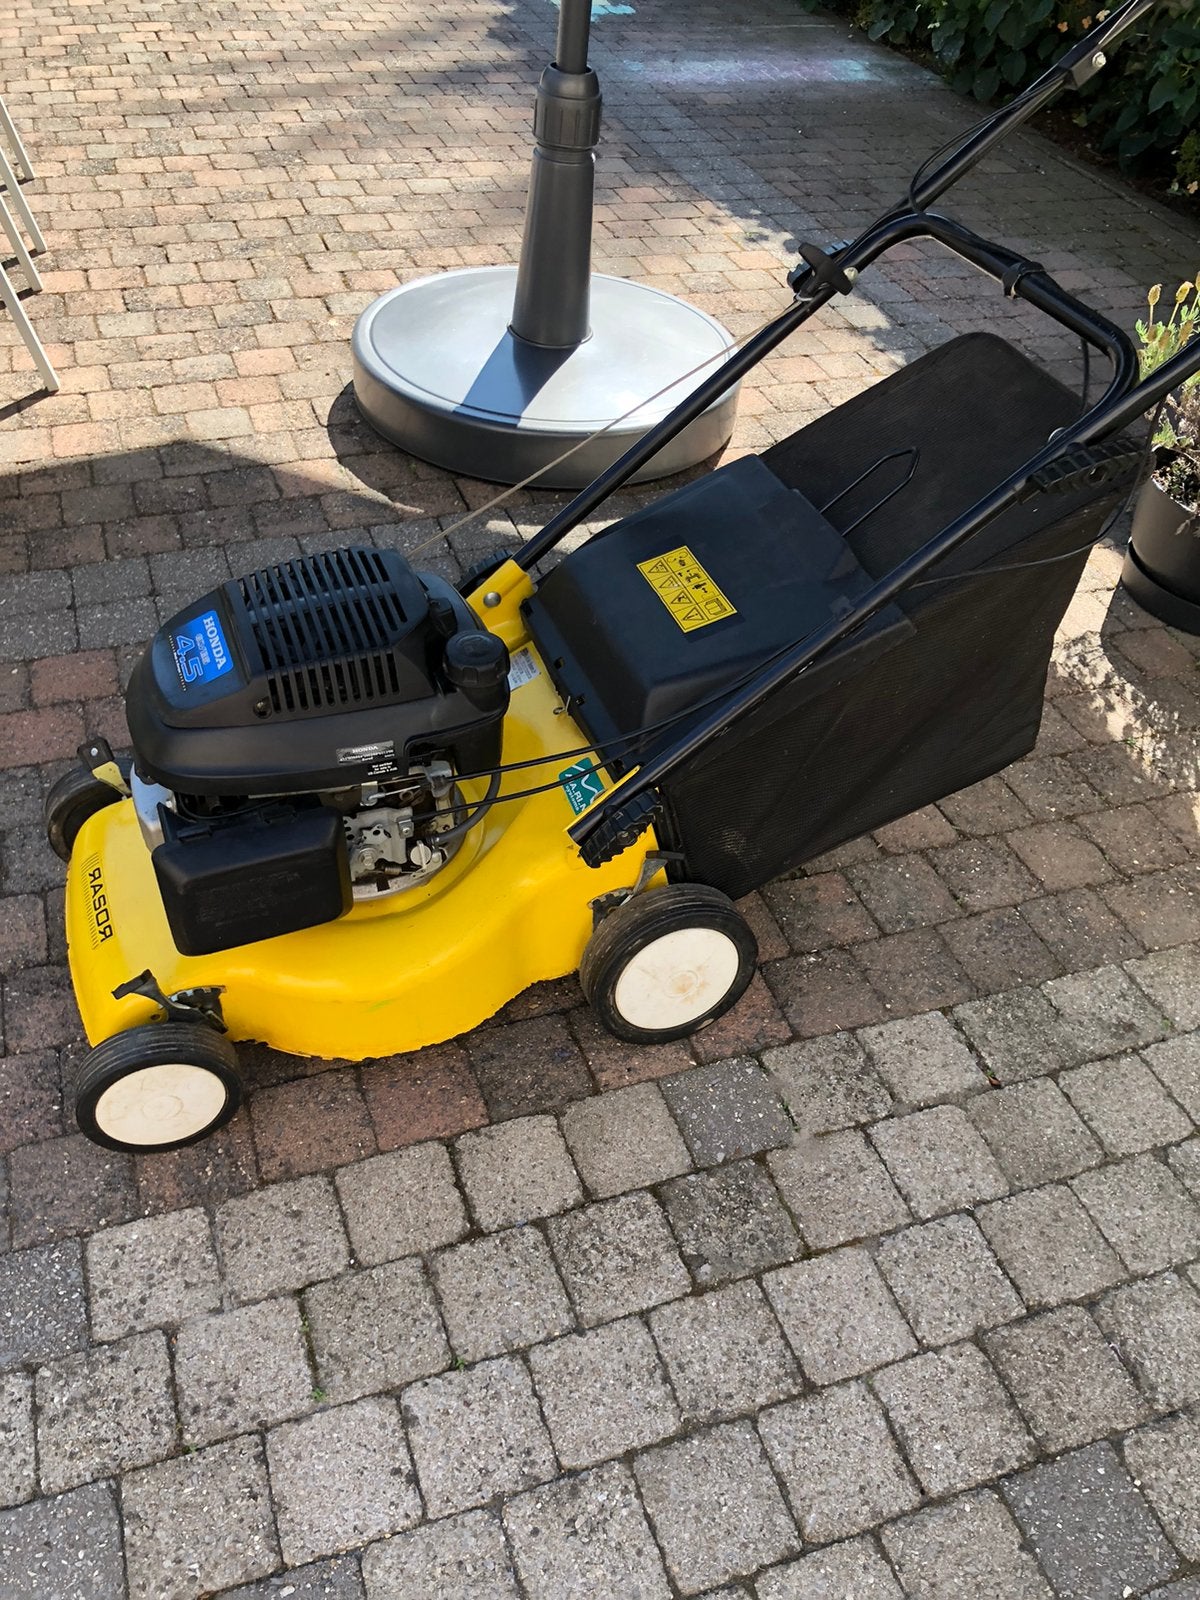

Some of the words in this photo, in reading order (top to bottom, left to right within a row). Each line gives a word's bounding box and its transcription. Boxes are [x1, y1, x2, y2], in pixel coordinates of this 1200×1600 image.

[176, 635, 204, 682] 4.5
[203, 615, 227, 670] HONDA
[352, 745, 379, 753] HONDA
